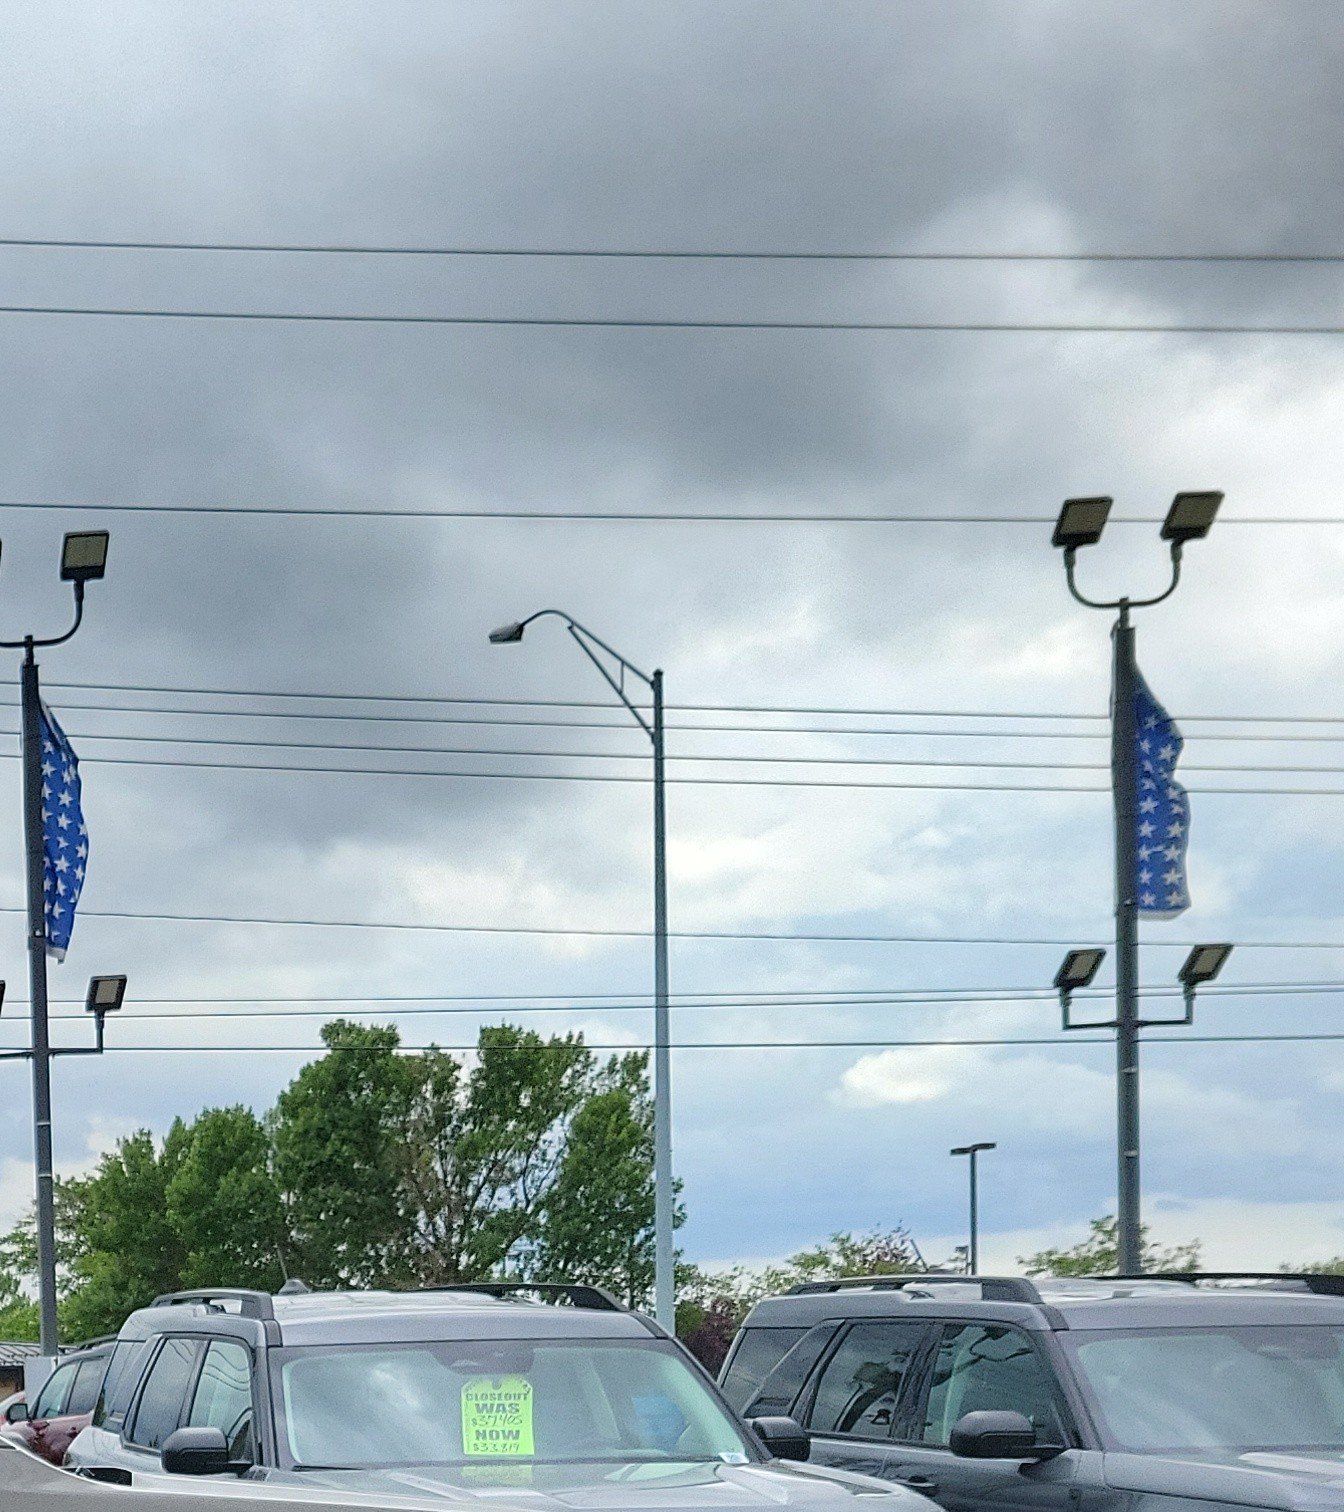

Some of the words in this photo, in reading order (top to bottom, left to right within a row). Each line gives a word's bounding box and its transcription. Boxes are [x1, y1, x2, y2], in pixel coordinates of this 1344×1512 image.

[466, 1392, 528, 1401] CLOSEOUT
[475, 1403, 520, 1414] WAS
[475, 1429, 520, 1441] NOW
